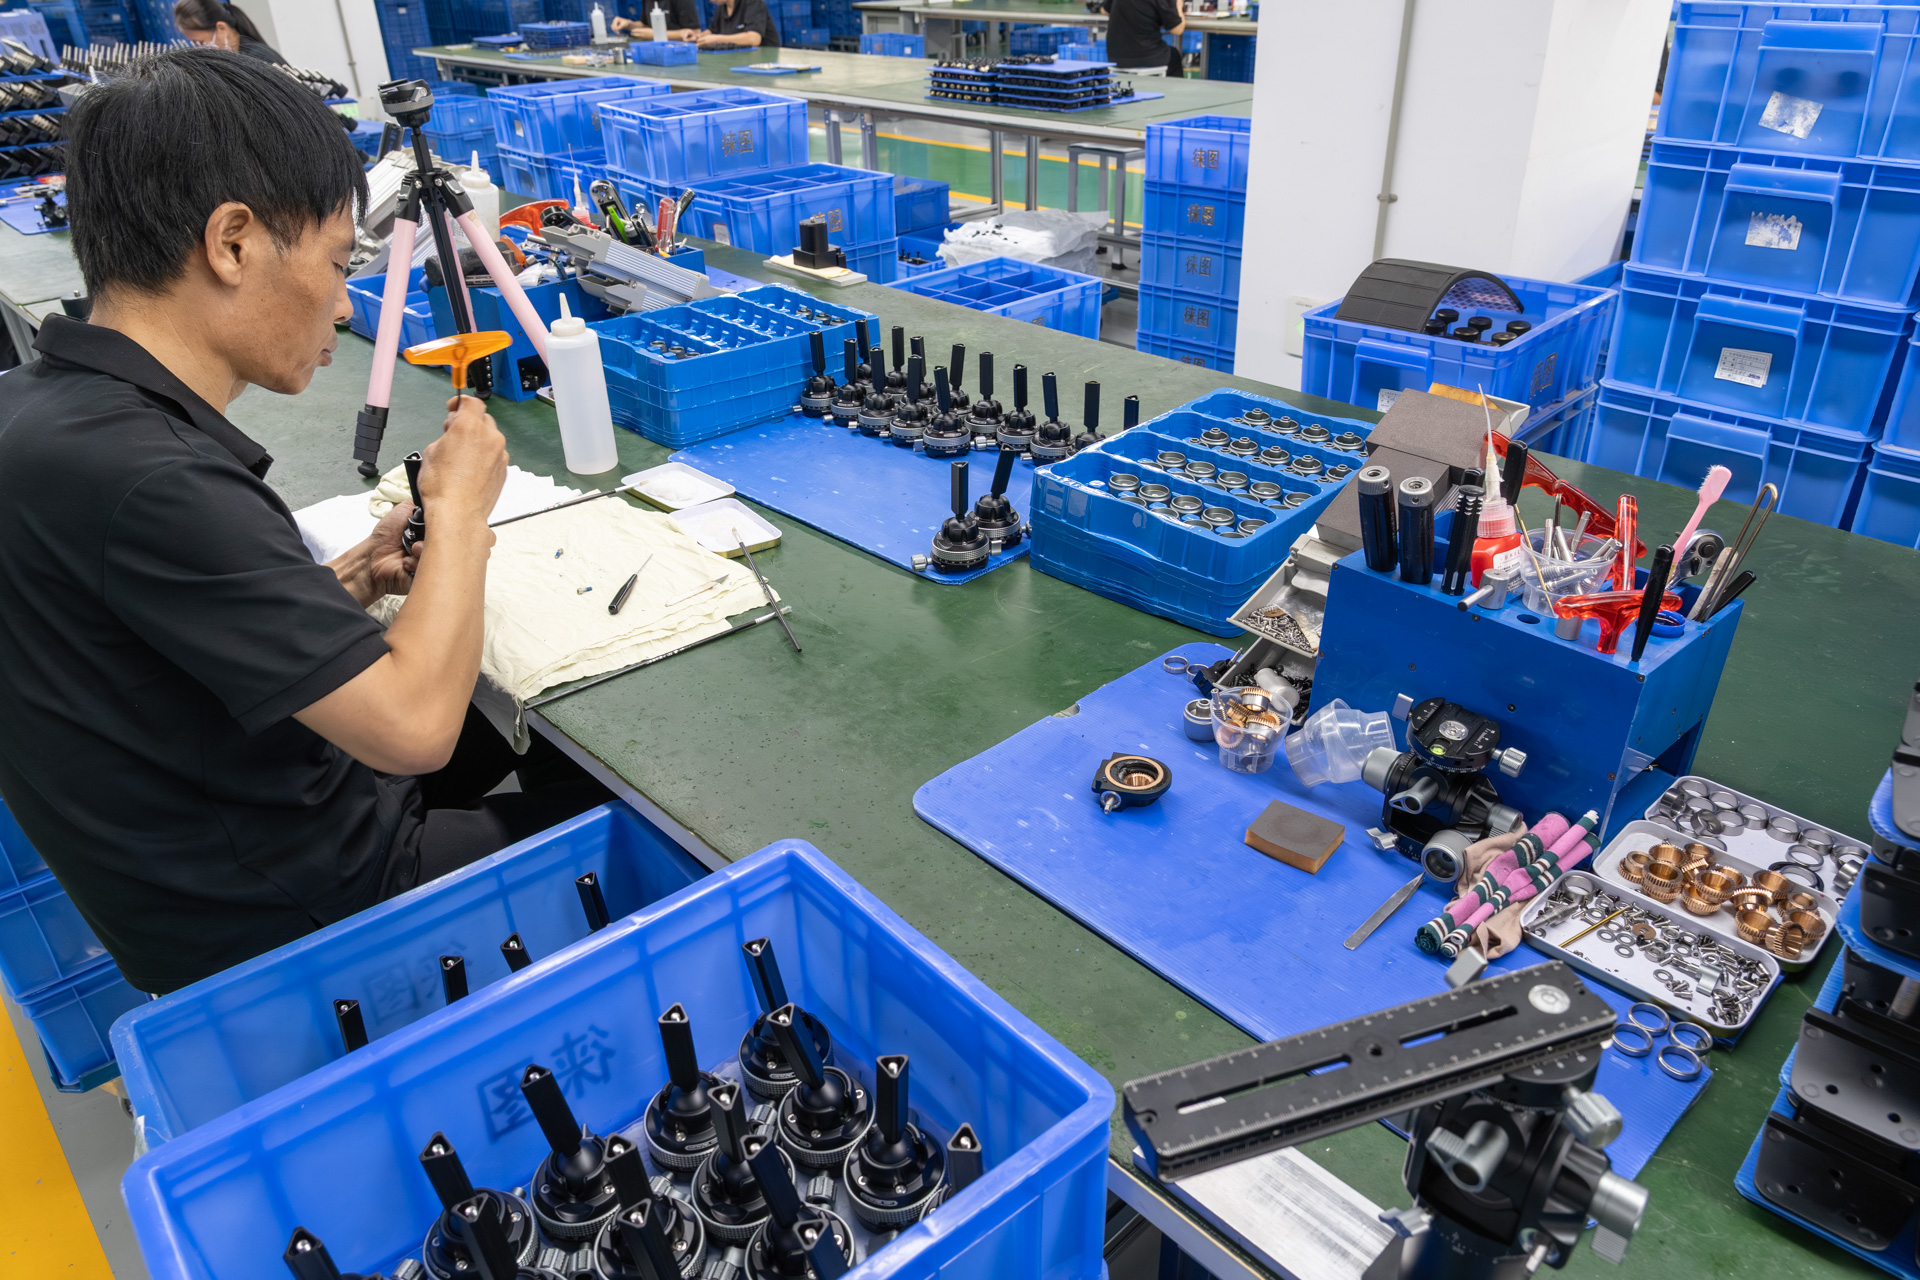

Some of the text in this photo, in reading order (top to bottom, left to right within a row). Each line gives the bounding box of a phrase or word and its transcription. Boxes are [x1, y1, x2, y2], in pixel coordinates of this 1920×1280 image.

[721, 129, 754, 157] 徕图
[1192, 147, 1219, 171] 徕图
[1187, 203, 1215, 226] 徕图
[1185, 253, 1212, 277] 徕图
[1183, 305, 1210, 328] 徕图
